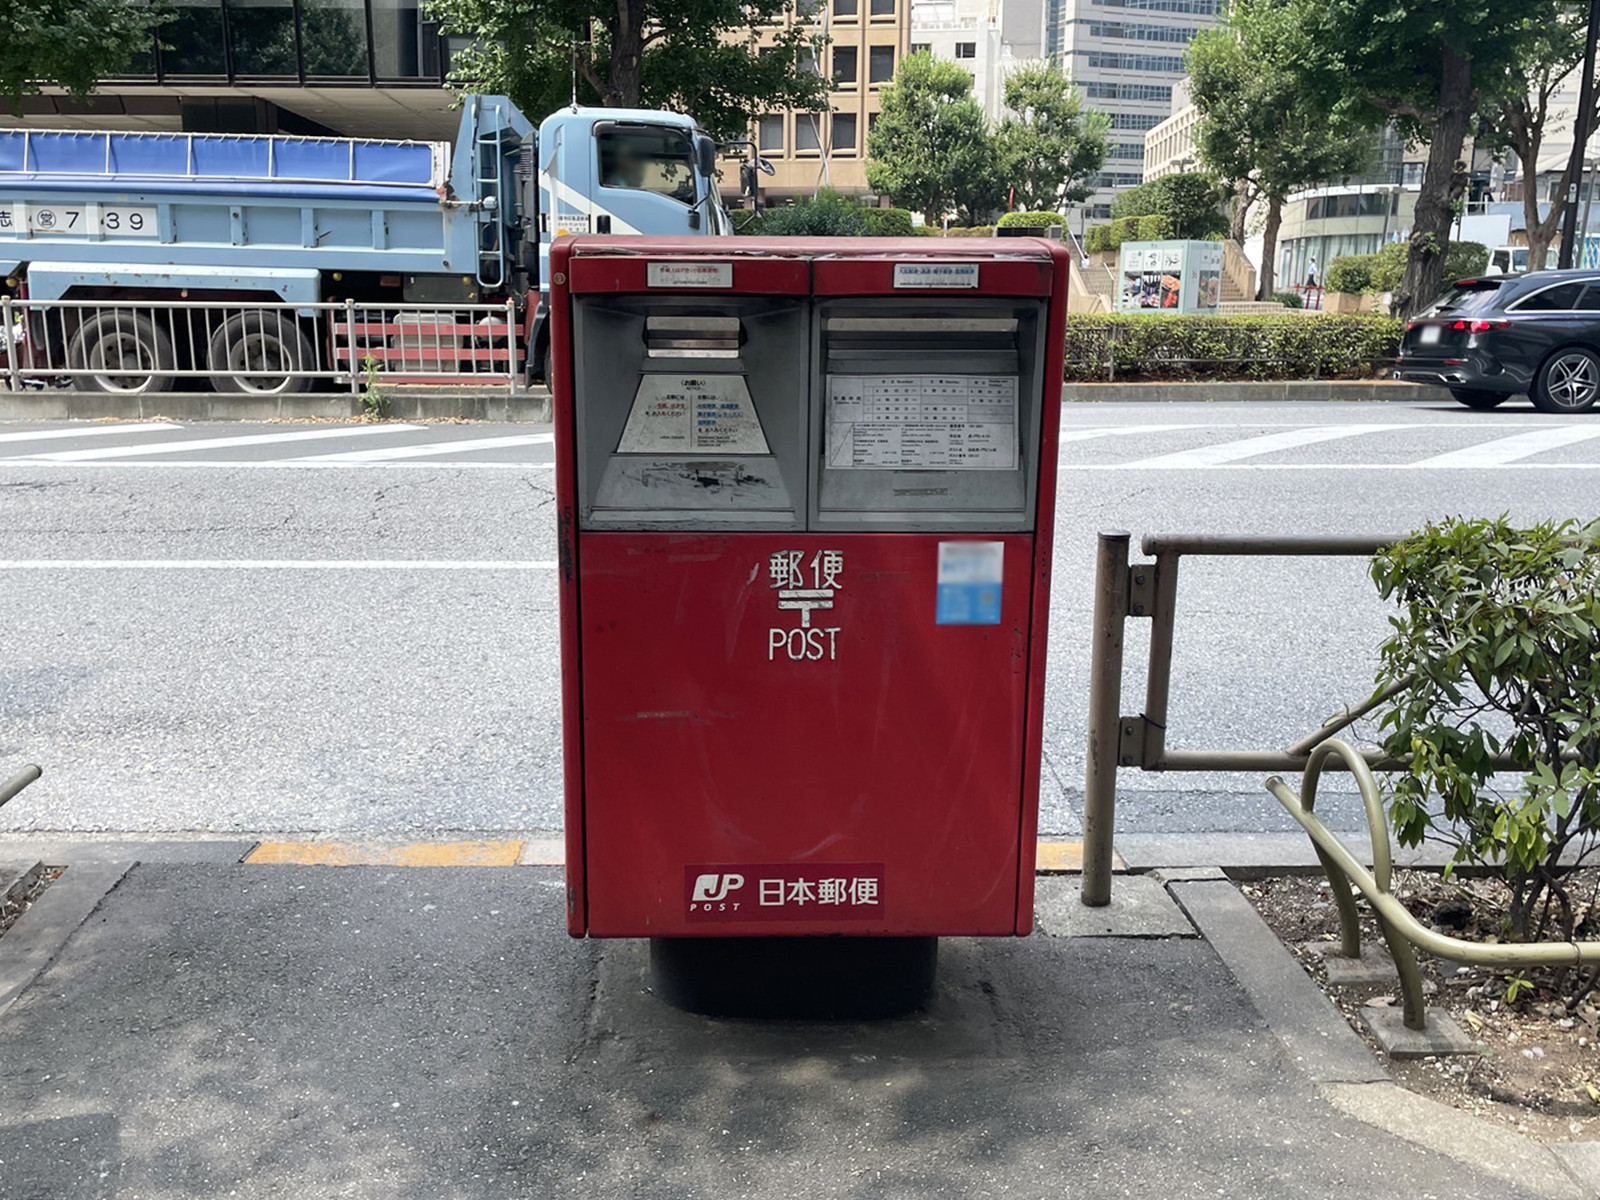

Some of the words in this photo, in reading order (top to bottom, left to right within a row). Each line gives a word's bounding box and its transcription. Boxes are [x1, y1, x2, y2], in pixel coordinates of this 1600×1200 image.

[769, 550, 844, 589] 郵便
[769, 628, 842, 660] POST
[759, 878, 879, 906] 日本郵便
[690, 903, 740, 912] POST
